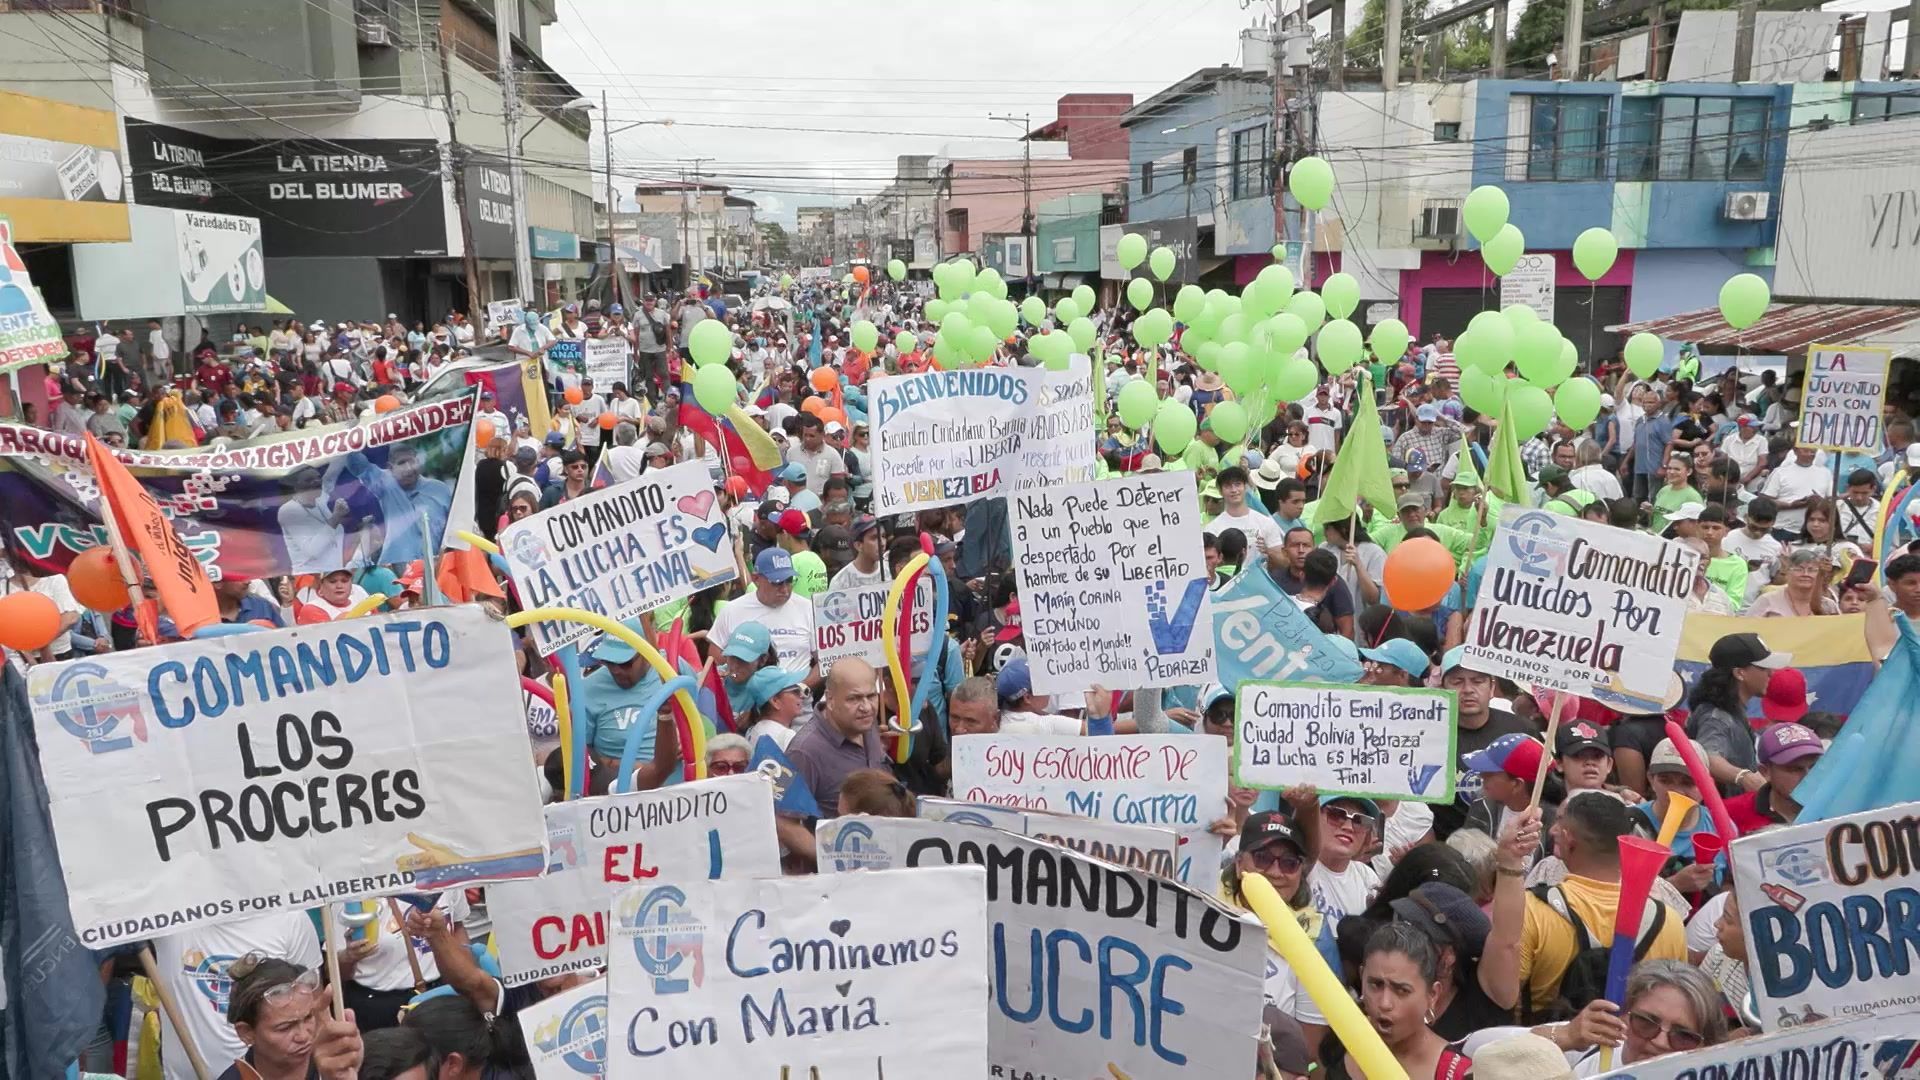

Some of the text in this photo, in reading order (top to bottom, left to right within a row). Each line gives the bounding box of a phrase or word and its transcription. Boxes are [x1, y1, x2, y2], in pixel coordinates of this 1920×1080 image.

[153, 142, 204, 168] LA TIENDA
[276, 155, 391, 172] LA TIENDA
[152, 172, 212, 198] DEL BLUMER
[269, 183, 404, 200] DEL BLUMER
[480, 166, 490, 191] LA
[186, 213, 252, 235] Variedades Ely
[480, 199, 512, 224] DEL BLUME
[550, 351, 583, 359] ANAR
[551, 343, 577, 352] MOS
[1815, 352, 1847, 371] LA
[878, 371, 1028, 431] BIENVENIDOS
[1808, 375, 1881, 396] JUVENTUD
[1806, 396, 1871, 410] ESTA CON
[1801, 412, 1879, 448] EDMUNDO
[255, 427, 364, 468] IGNACIO
[882, 456, 925, 480] Presente
[881, 486, 899, 508] de
[903, 468, 1001, 504] VENEZUELA
[1017, 482, 1184, 520] Nada Puede Detener
[547, 483, 676, 551] COMANDITO:
[1018, 525, 1027, 541] a
[1041, 527, 1060, 540] un
[1123, 517, 1150, 537] que
[1160, 508, 1180, 526] ha
[524, 515, 687, 608] LA LUCHA ES
[1020, 544, 1096, 566] despertado
[1148, 535, 1163, 555] el
[631, 551, 698, 600] FINAL
[1024, 569, 1069, 588] hambre
[1075, 566, 1090, 581] de
[1122, 557, 1189, 582] LIBERTAD
[1567, 538, 1692, 600] Comandito
[615, 611, 627, 622] LA
[628, 595, 671, 616] LIBERTAD
[1079, 589, 1122, 606] CORINA
[1493, 567, 1661, 636] Unidos Por
[818, 624, 846, 649] LOS
[1210, 570, 1323, 682] Vent
[1476, 604, 1625, 672] Venezuela
[1079, 635, 1090, 651] el
[147, 620, 451, 729] COMANDITO
[1047, 653, 1090, 675] Ciudad
[1096, 653, 1138, 675] Bolivia
[1463, 645, 1610, 684] CIUDADANOS POR LA
[1505, 669, 1569, 690] LIBERTAD
[1254, 691, 1447, 722] Comandito Emil Brandt
[237, 710, 354, 779] LOS
[1243, 719, 1294, 745] Ciudad
[1305, 721, 1355, 747] Bolivia
[1252, 746, 1270, 766] La
[1277, 745, 1316, 766] Lucha
[1351, 747, 1389, 766] Hasta
[1399, 749, 1414, 767] el
[145, 768, 426, 862] PROCERES
[590, 791, 728, 838] COMANDITO
[1065, 790, 1103, 819] Mi
[604, 843, 659, 882] EL
[81, 898, 235, 946] CIUDADANOS
[238, 893, 282, 914] POR
[315, 869, 417, 902] LIBERTAD
[532, 911, 608, 960] CAI
[725, 909, 958, 978] Caminemos
[1750, 887, 1920, 997] BORR
[503, 956, 602, 986] CIUDADANOS
[991, 922, 1192, 1065] UCRE
[627, 1007, 719, 1057] Con
[1677, 1036, 1870, 1080] MANDITO:
